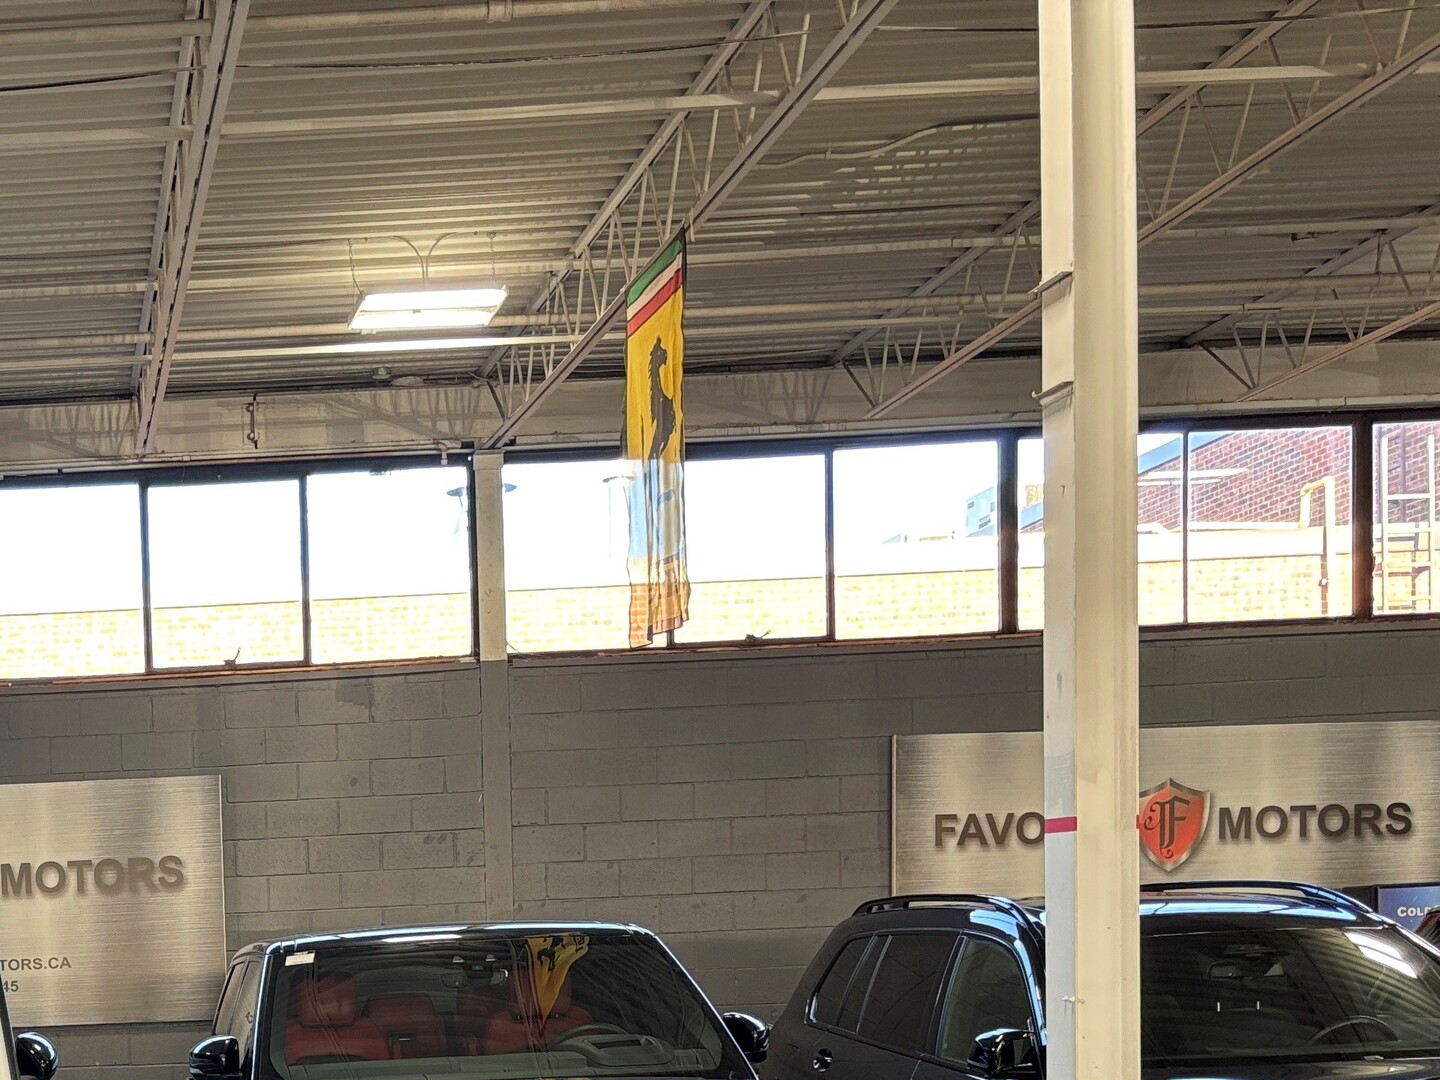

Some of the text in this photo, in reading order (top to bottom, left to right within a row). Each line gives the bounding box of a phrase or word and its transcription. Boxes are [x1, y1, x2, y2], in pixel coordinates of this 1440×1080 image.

[934, 811, 1046, 847] FAVO
[1218, 802, 1412, 840] MOTORS
[0, 855, 185, 896] MOTORS
[3, 980, 20, 993] 45
